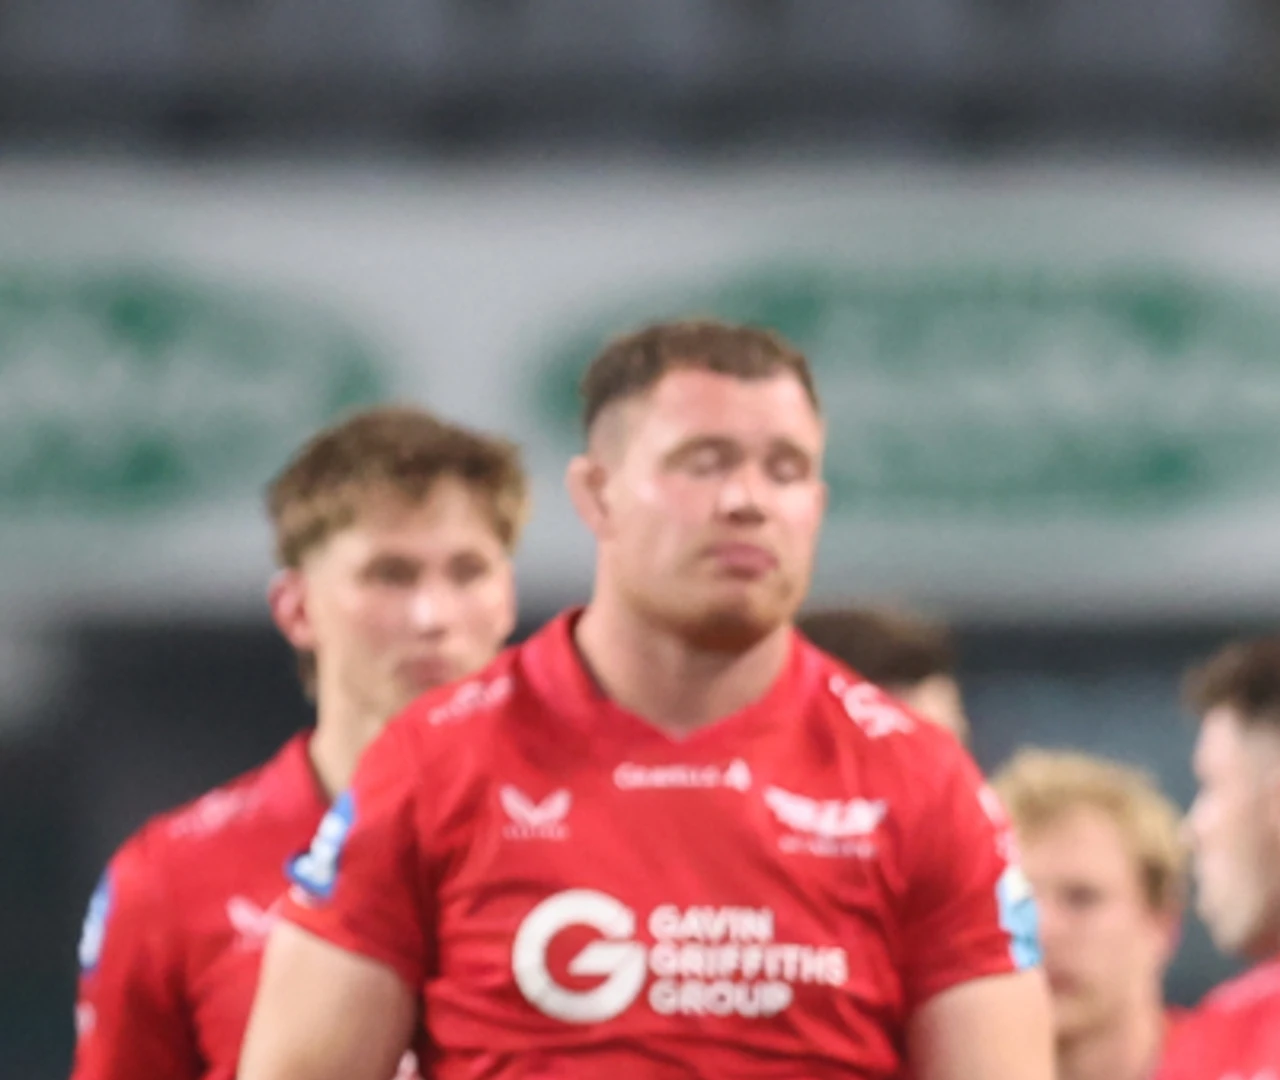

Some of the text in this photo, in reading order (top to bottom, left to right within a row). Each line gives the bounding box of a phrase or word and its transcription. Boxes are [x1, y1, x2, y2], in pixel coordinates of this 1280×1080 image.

[648, 905, 775, 942] GAVIN
[648, 942, 848, 986] GRIFFITHS
[648, 979, 793, 1017] GROUP
